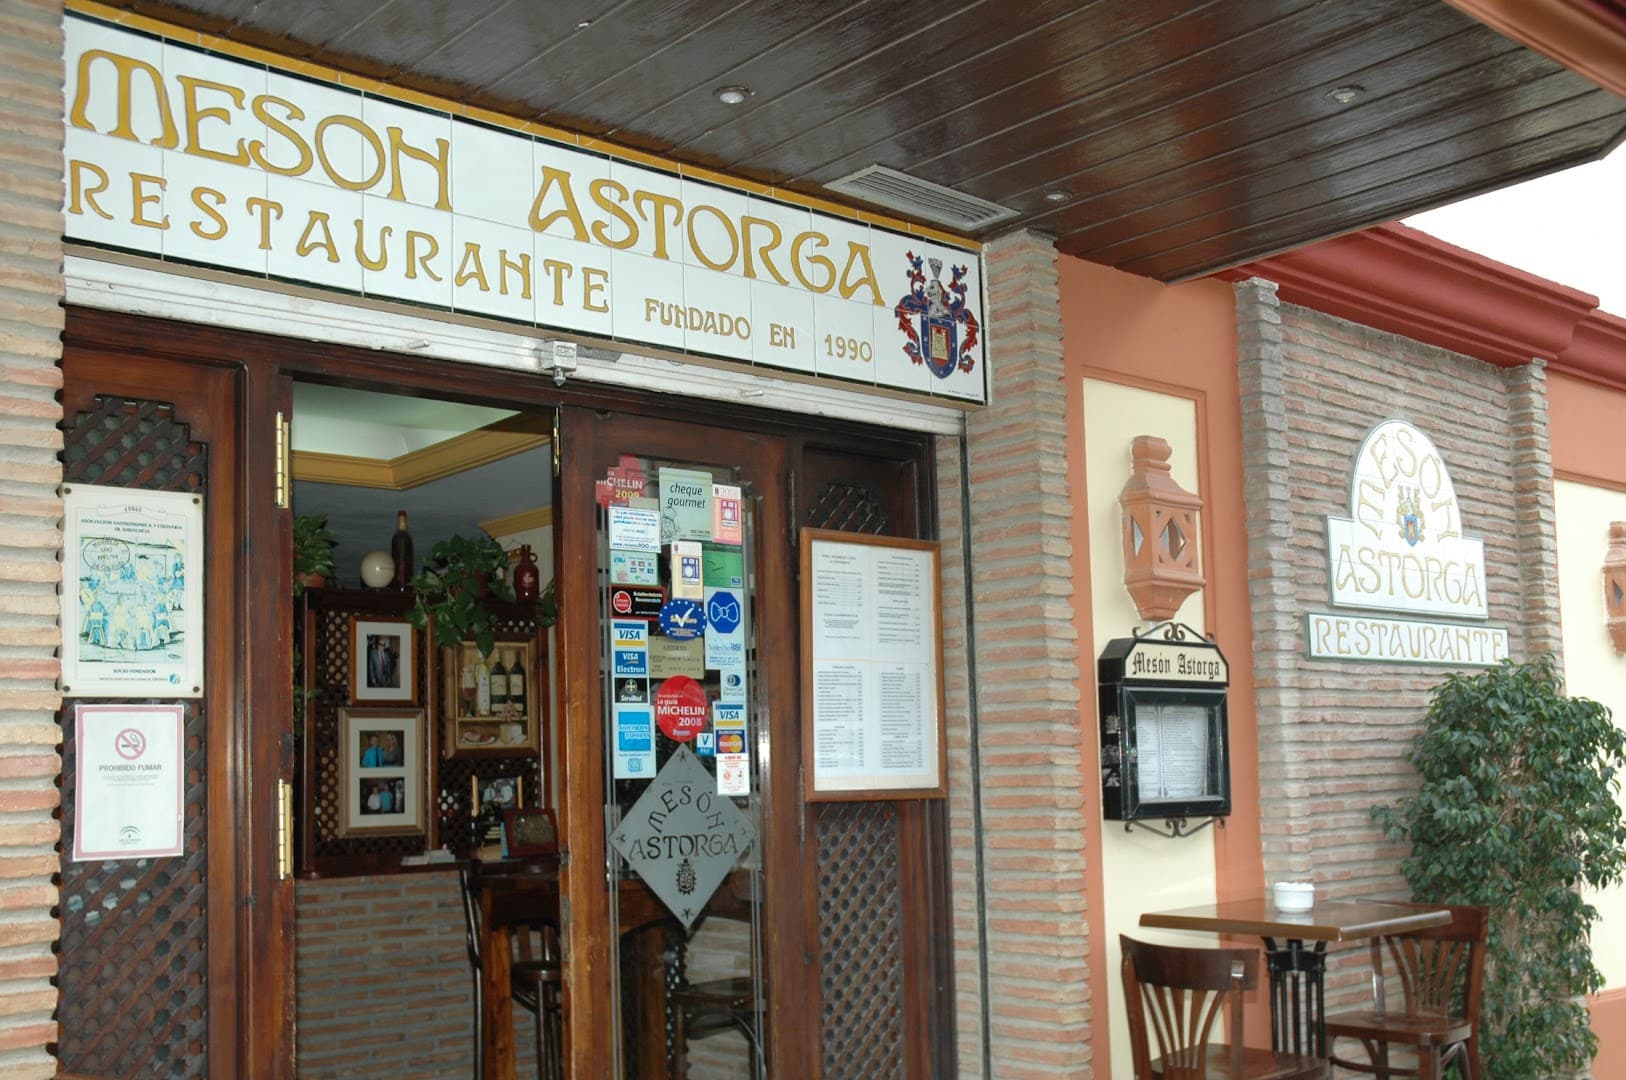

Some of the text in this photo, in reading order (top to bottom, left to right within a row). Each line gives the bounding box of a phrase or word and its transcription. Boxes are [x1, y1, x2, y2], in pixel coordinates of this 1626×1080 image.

[70, 49, 886, 306] MESON ASTORGA
[68, 159, 609, 313] RESTAURANTE
[644, 298, 873, 363] FUNDADO EN 1990
[670, 483, 703, 497] cheque
[667, 496, 706, 509] gourmet
[1336, 544, 1483, 608] ASTORGA
[619, 629, 640, 640] VISA
[1314, 617, 1506, 663] RESTAURANTE
[622, 652, 639, 661] VISA
[616, 665, 645, 673] Electron
[1131, 651, 1220, 680] Mesón Astorga
[657, 705, 705, 716] MICHELIN
[720, 710, 739, 720] VISA
[678, 717, 702, 726] 2008
[701, 735, 710, 746] V
[628, 832, 739, 861] ASTORGA
